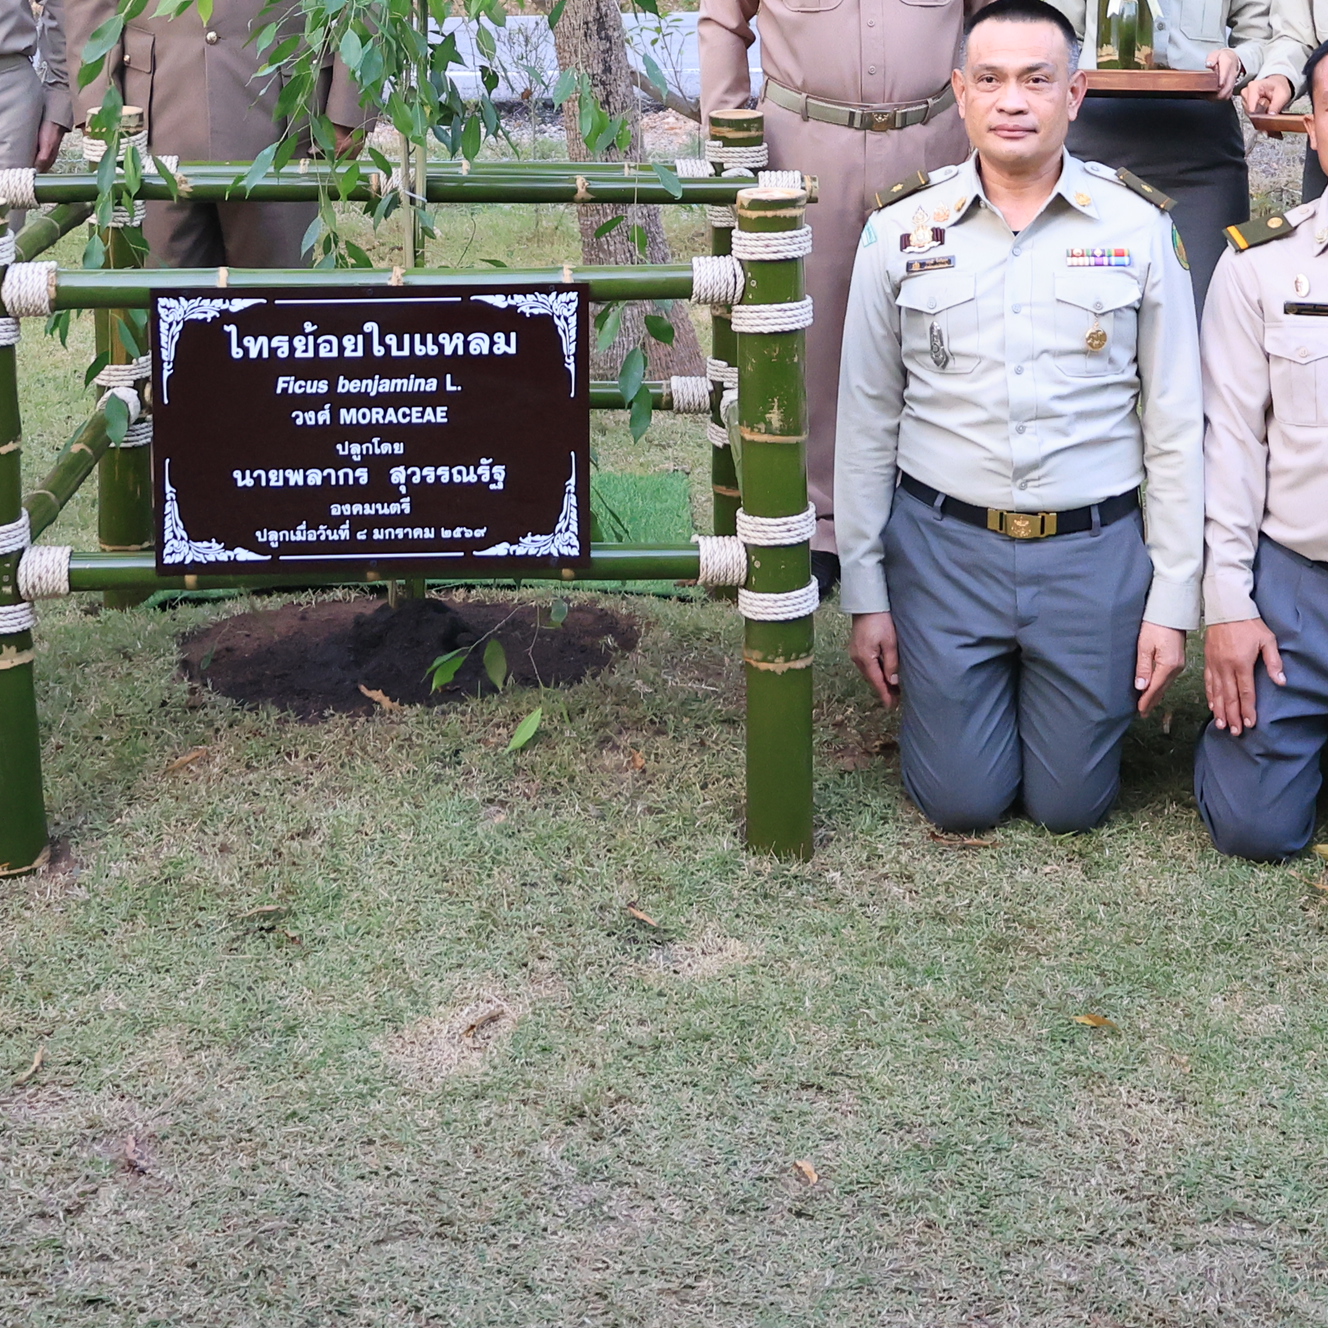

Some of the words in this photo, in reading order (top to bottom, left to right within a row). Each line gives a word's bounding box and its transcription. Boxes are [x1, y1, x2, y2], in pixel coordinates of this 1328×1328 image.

[224, 322, 517, 359] ไทรย้อยใบแหลม
[276, 375, 329, 394] Ficus
[336, 374, 438, 397] benjamina
[445, 373, 462, 392] L.
[292, 404, 331, 426] วงศ์
[339, 406, 448, 425] MORACEAE
[336, 438, 404, 461] ปลูกโดย
[232, 467, 369, 487] นายพลากร
[389, 457, 506, 494] สุวรรณรัฐ
[330, 497, 411, 516] องคมนตรี
[255, 520, 350, 547] ปลูกเมื่อวันที่
[356, 528, 368, 540] ๘
[372, 527, 435, 540] มกราคม
[441, 525, 487, 540] ๒๕๖๙
